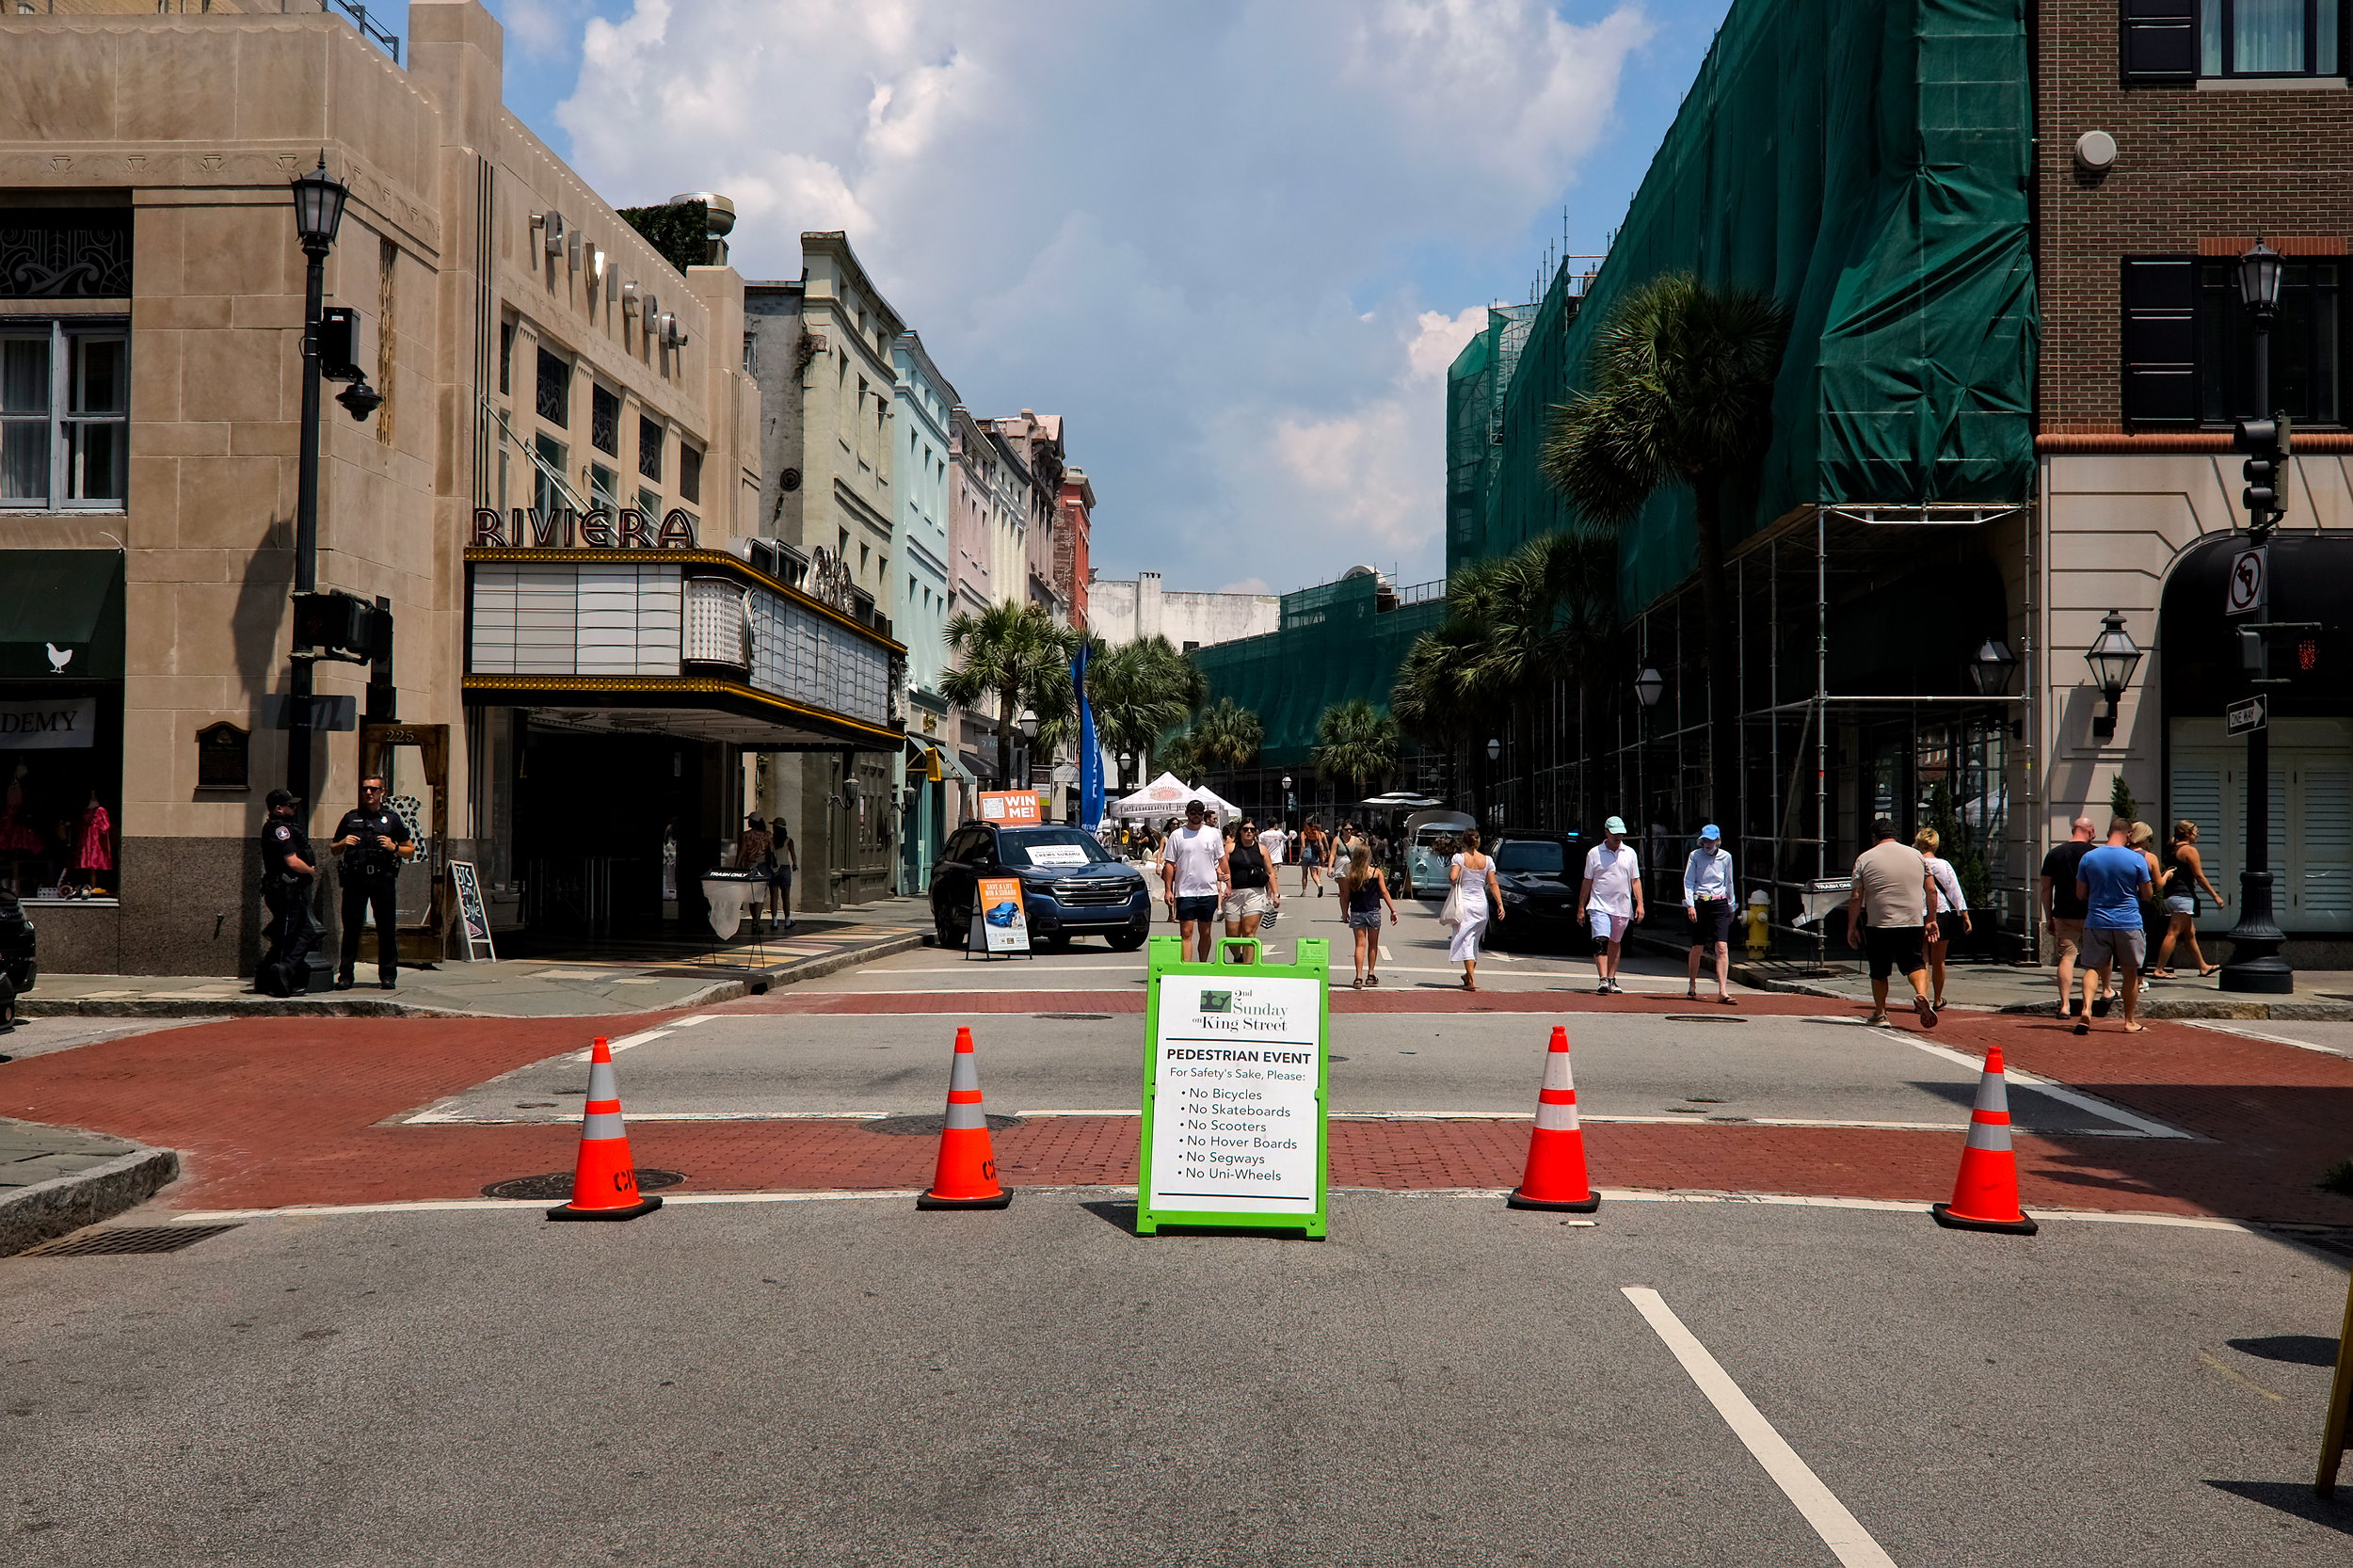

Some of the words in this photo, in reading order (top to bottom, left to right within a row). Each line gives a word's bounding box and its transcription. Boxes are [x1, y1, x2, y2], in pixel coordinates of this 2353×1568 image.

[473, 507, 695, 547] RIVIERA
[2232, 712, 2242, 725] ONE
[2244, 708, 2254, 721] WAY
[386, 729, 414, 742] 225
[1004, 795, 1036, 807] WIN
[1120, 802, 1172, 813] permanent
[1008, 808, 1034, 819] ME!
[1234, 990, 1253, 1001] 2nd
[1233, 1002, 1288, 1019] Sunday
[1202, 1016, 1239, 1032] King
[1242, 1017, 1288, 1032] Street
[1167, 1048, 1258, 1063] PEDESTRIAN
[1263, 1051, 1311, 1064] EVENT
[1170, 1067, 1187, 1077] For
[1191, 1067, 1232, 1080] Safety's
[1235, 1069, 1264, 1080] Sake,
[1267, 1069, 1305, 1081] Please:
[1190, 1088, 1209, 1098] No
[1212, 1088, 1262, 1102] Bicycles
[1189, 1103, 1208, 1113] No
[1211, 1104, 1290, 1117] Skateboards
[1188, 1119, 1207, 1129] No
[1210, 1120, 1267, 1132] Scooters
[1187, 1135, 1206, 1145] No
[1210, 1136, 1249, 1147] Hover
[1254, 1137, 1298, 1149] Boards
[1186, 1151, 1206, 1161] No
[1209, 1152, 1265, 1166] Segways
[1186, 1167, 1205, 1177] No
[1209, 1168, 1282, 1181] Uni-Wheels
